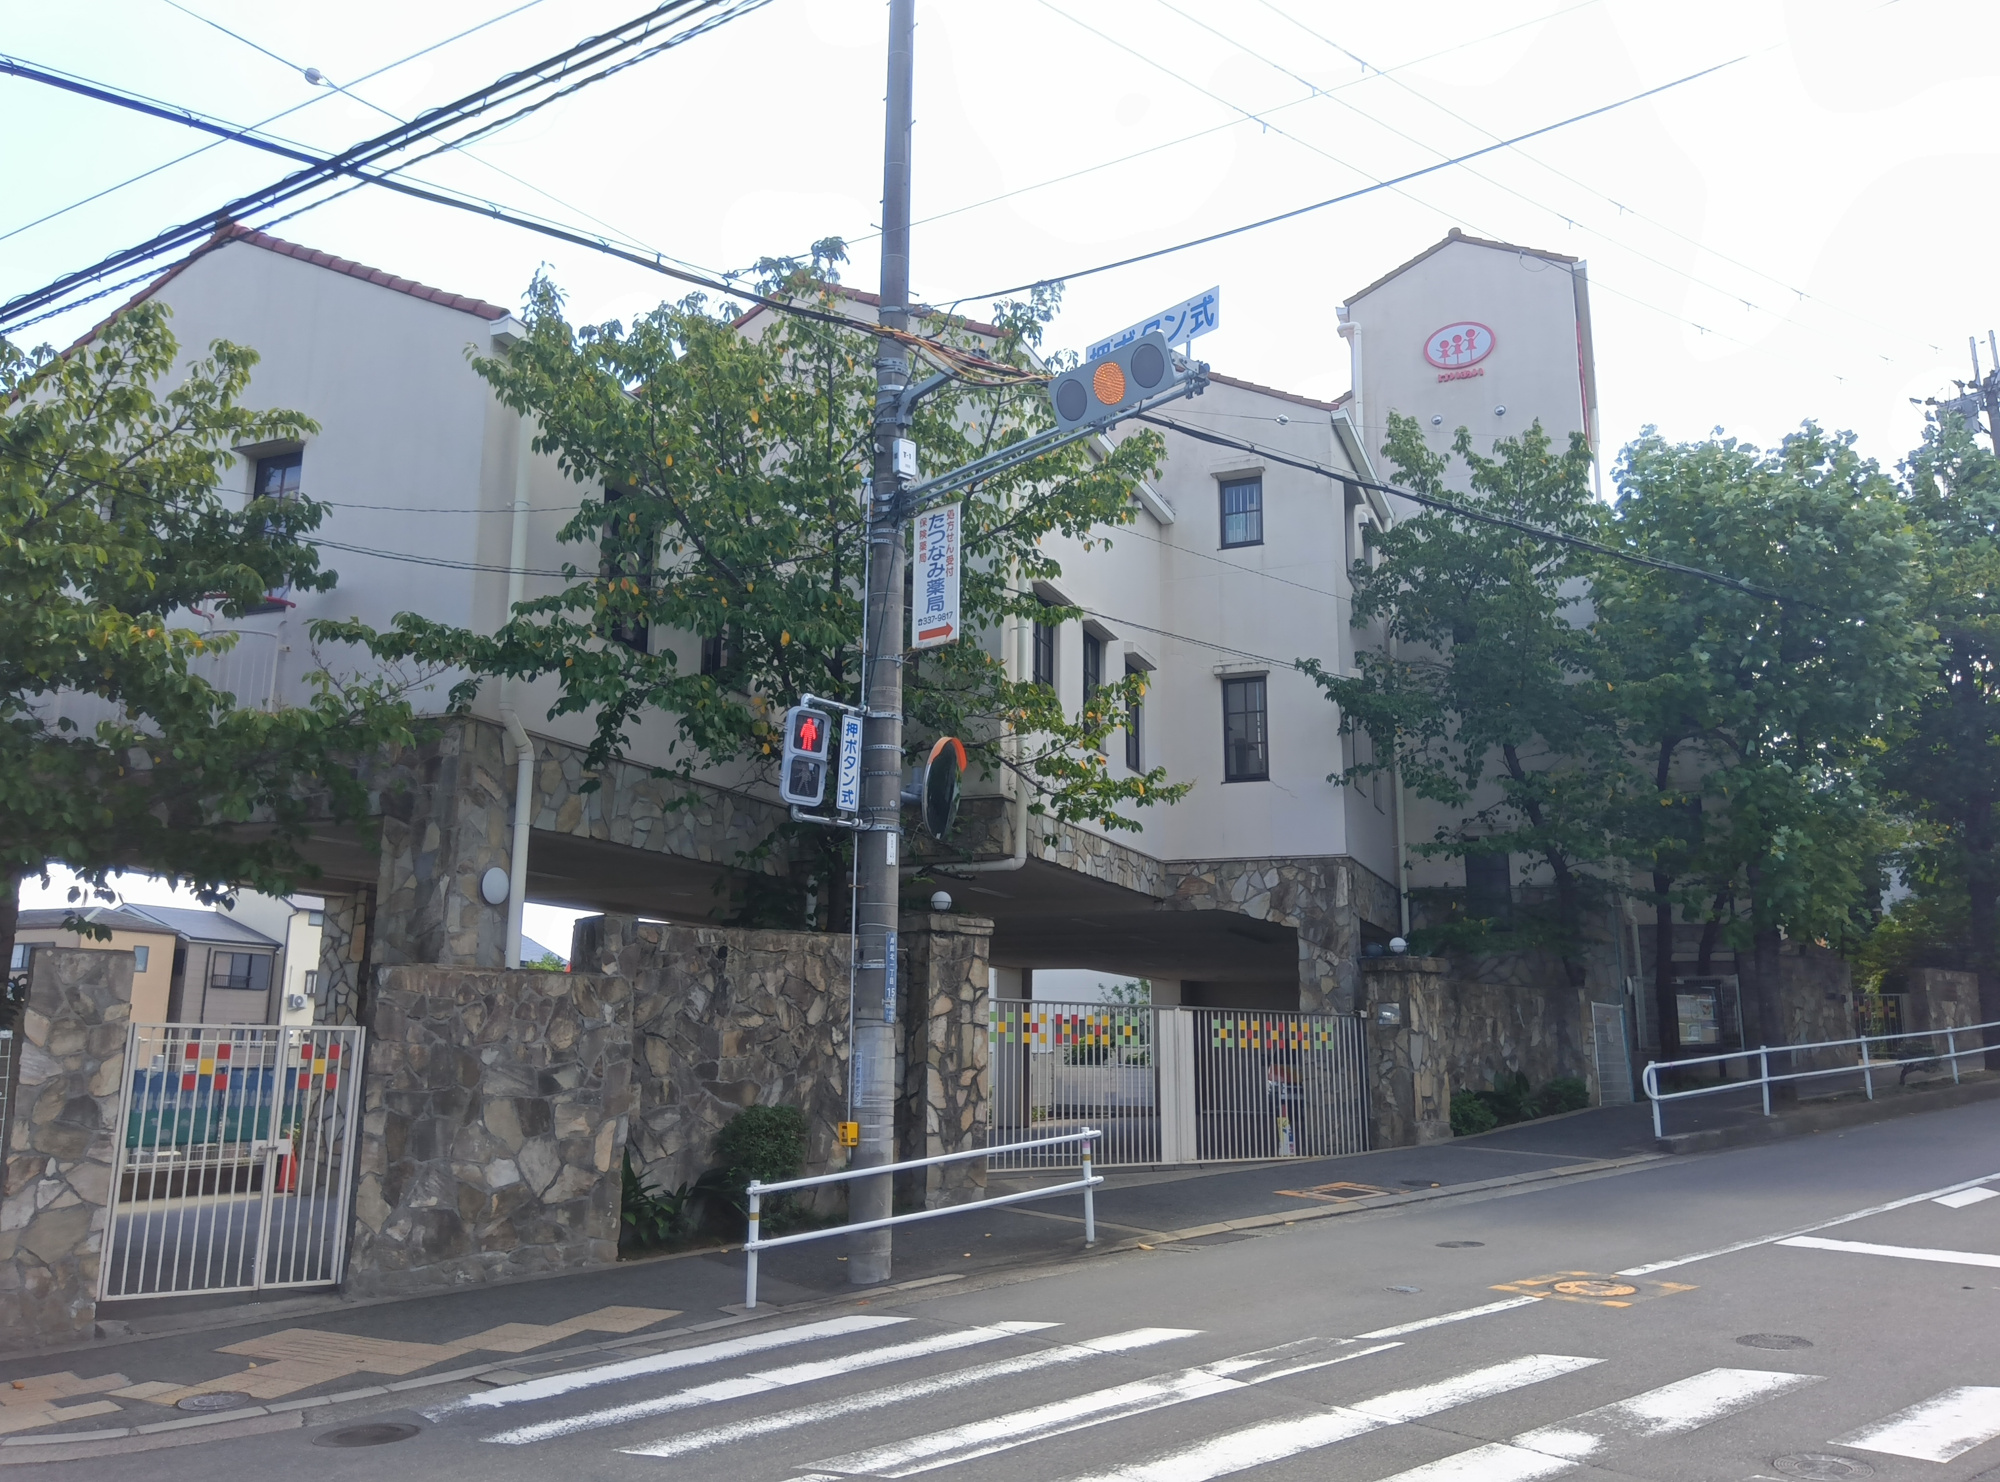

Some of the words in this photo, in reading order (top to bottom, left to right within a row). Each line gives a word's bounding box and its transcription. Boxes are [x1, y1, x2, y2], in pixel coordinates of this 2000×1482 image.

[919, 517, 927, 564] 保険薬局
[926, 513, 945, 614] たつなみ薬局
[946, 509, 955, 577] 処方せん受付
[841, 722, 858, 805] 押ボタン式
